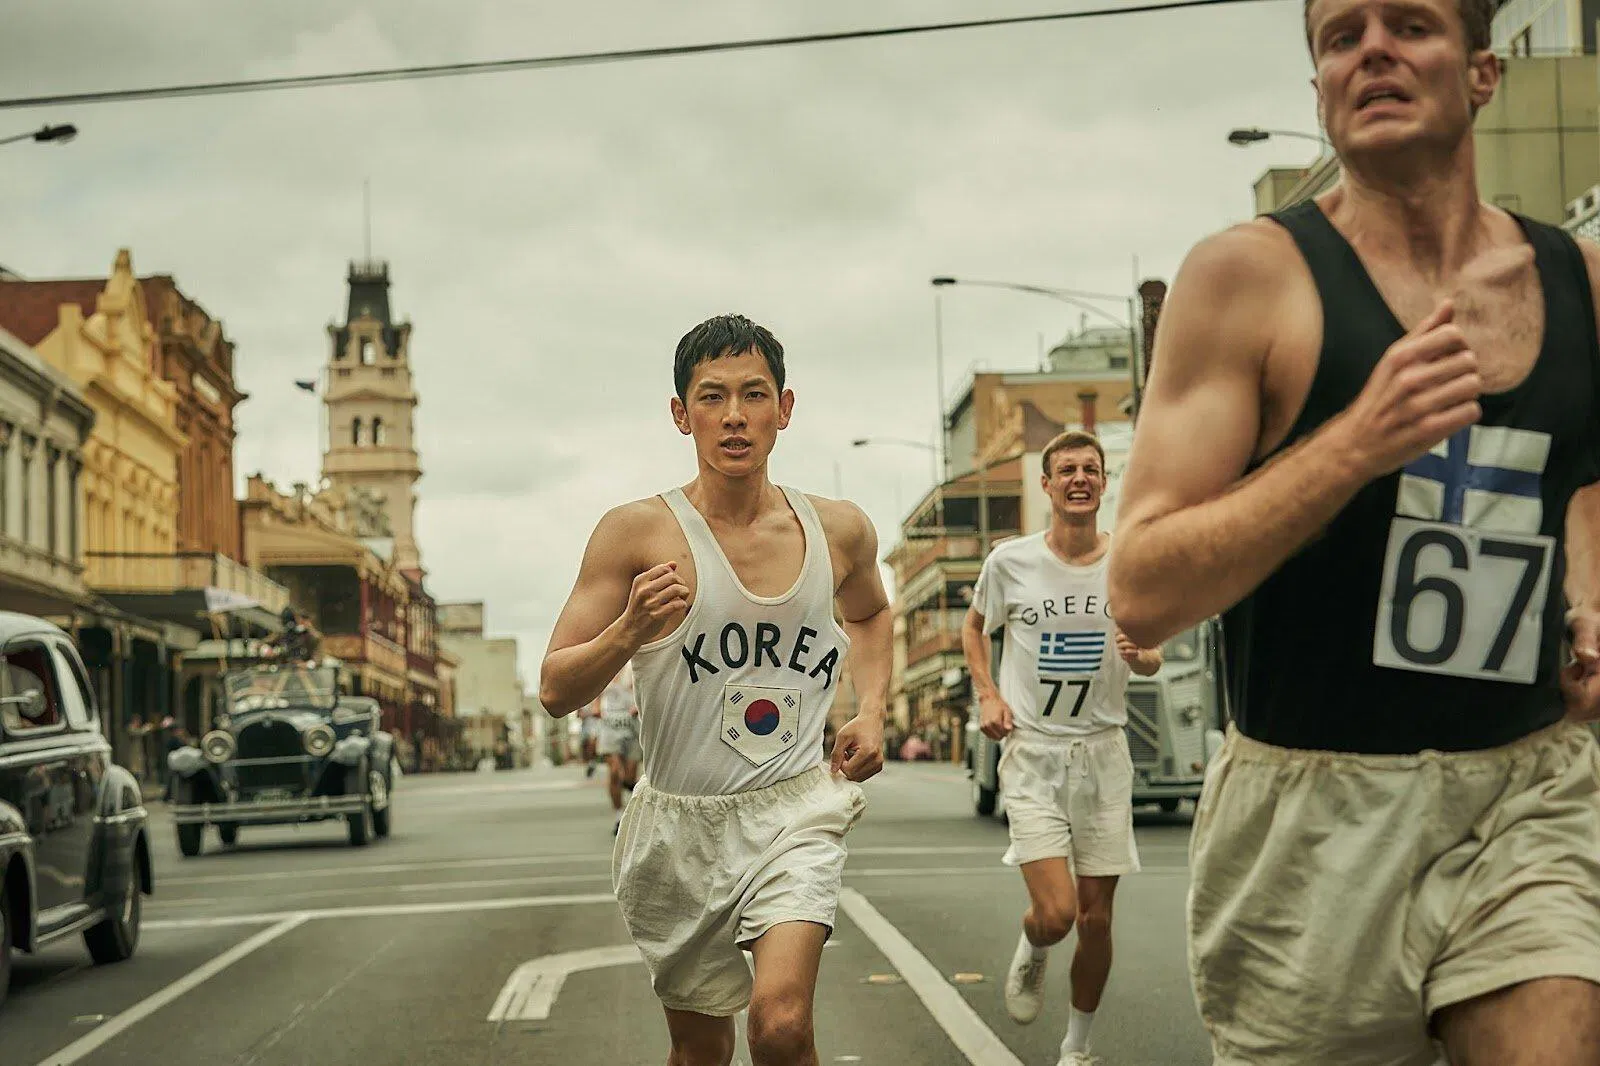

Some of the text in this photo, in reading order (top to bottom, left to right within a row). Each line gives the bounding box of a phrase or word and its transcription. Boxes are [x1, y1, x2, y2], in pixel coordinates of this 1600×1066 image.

[1391, 531, 1547, 671] 67
[682, 622, 839, 690] KOREA
[1040, 679, 1090, 717] 77
